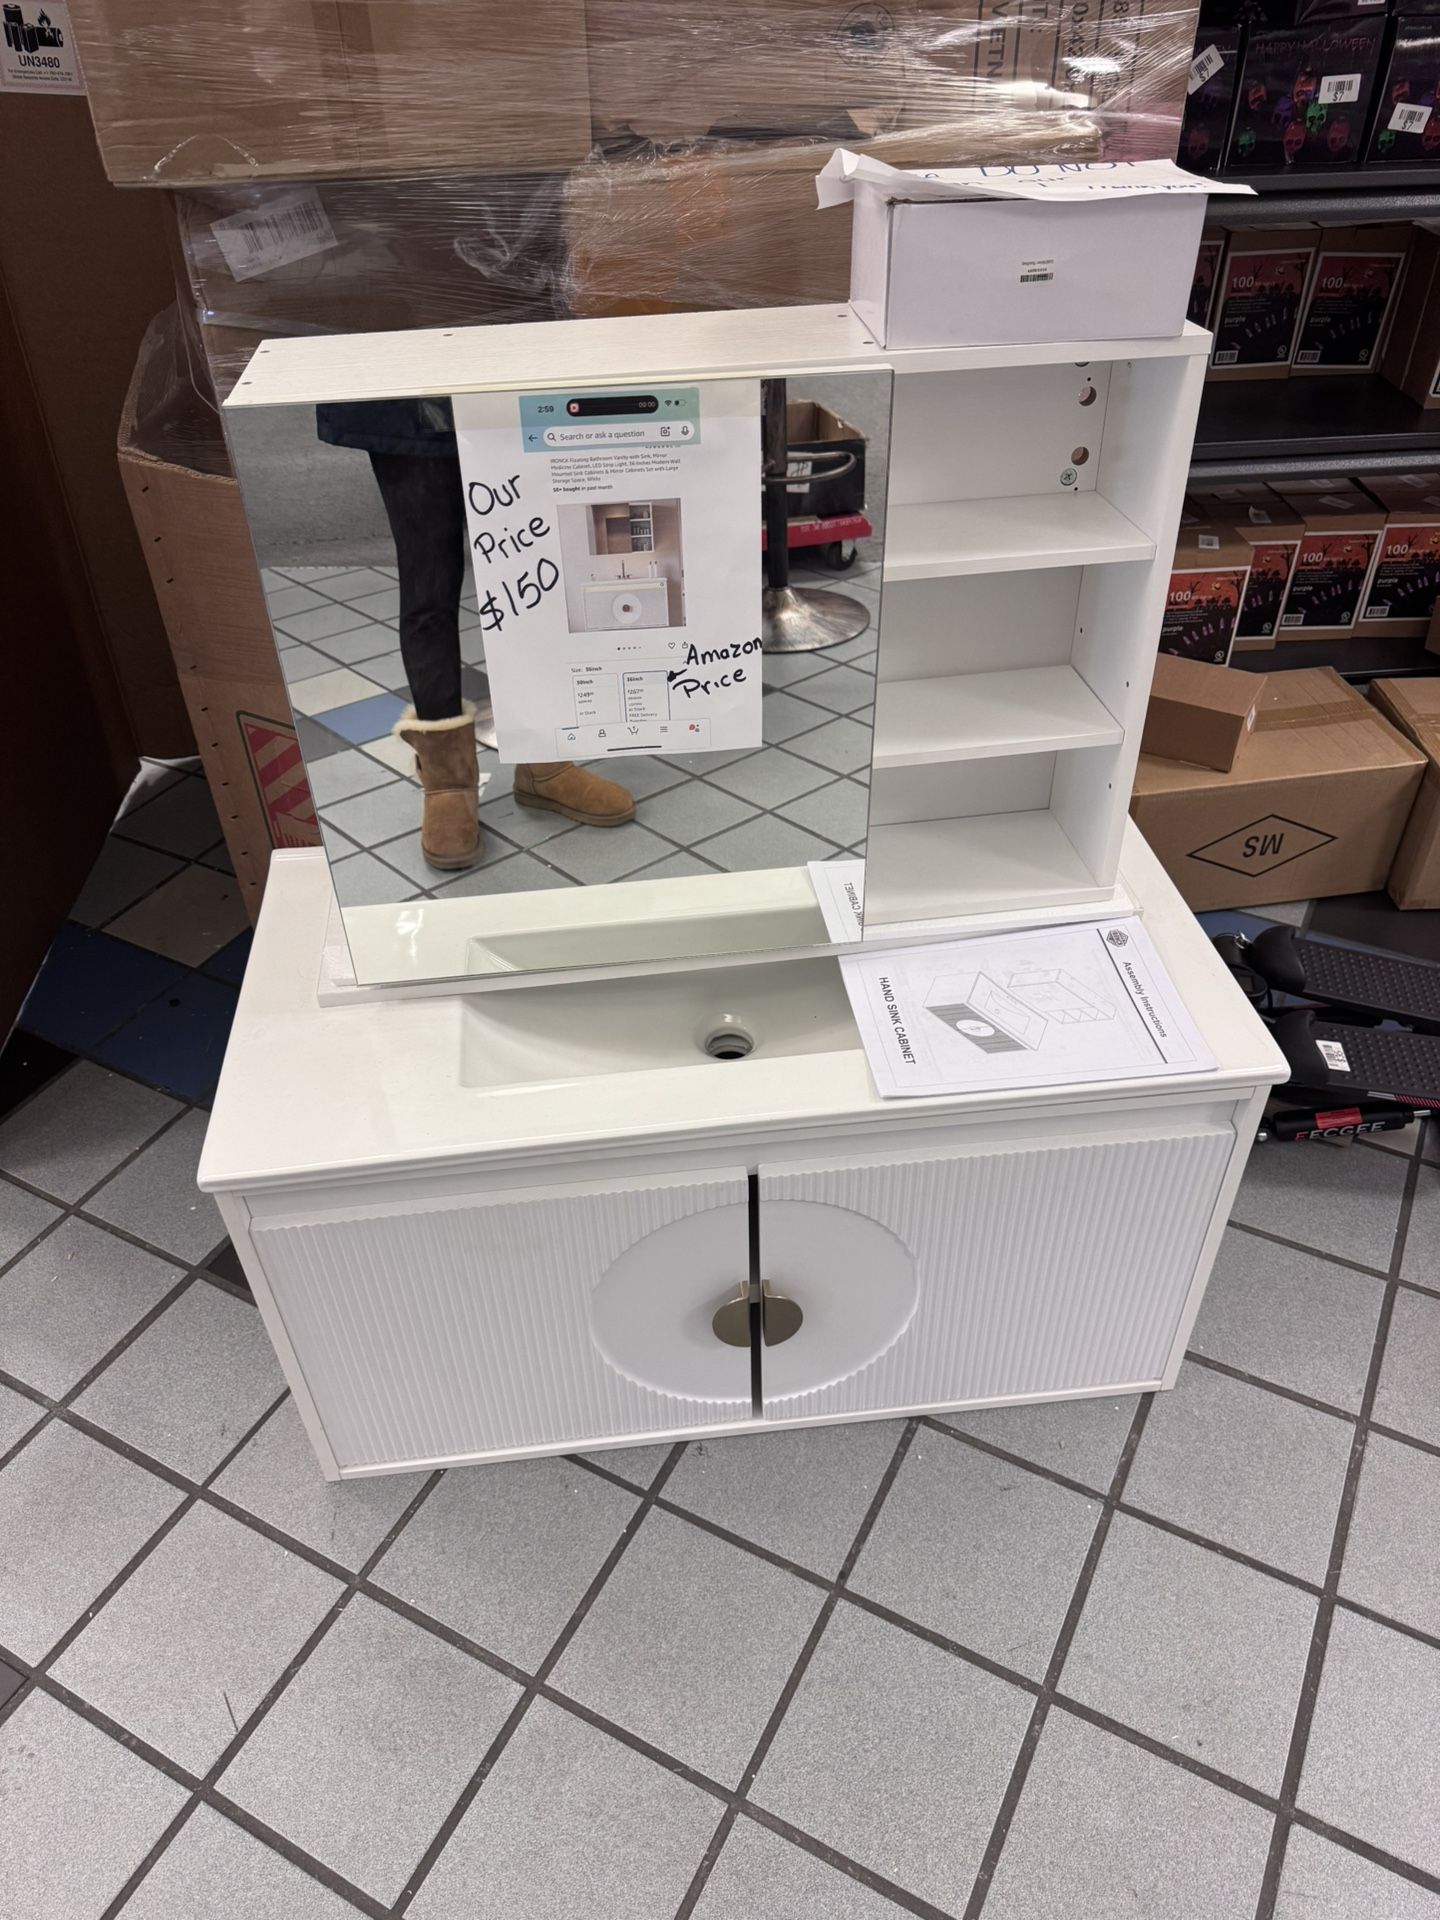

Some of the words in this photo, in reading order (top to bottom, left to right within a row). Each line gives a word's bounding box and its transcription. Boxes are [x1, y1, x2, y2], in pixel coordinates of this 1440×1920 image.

[1255, 42, 1296, 55] HAPPY
[18, 55, 60, 68] UN3480
[1199, 68, 1210, 82] $7
[1333, 92, 1344, 102] $7
[1402, 120, 1414, 130] $7
[1231, 277, 1255, 289] 100
[1321, 277, 1344, 289] 100
[1224, 315, 1246, 325] purple
[1309, 315, 1331, 325] purple
[559, 433, 584, 441] Search
[594, 431, 607, 439] ask
[614, 430, 645, 440] question
[468, 475, 521, 515] Our
[474, 517, 550, 563] Price
[1386, 544, 1409, 555] 100
[1302, 552, 1324, 563] 100
[1377, 577, 1398, 585] purple
[479, 558, 559, 631] $150
[1292, 585, 1313, 593] purple
[1169, 591, 1191, 602] 100
[1162, 625, 1183, 633] purple
[685, 637, 763, 666] Amazon
[672, 669, 746, 698] Price
[879, 976, 895, 1003] HAND
[1122, 961, 1145, 996] Assembly
[1140, 996, 1167, 1038] Instructions
[886, 1003, 902, 1026] SINK
[894, 1026, 916, 1065] CABINET
